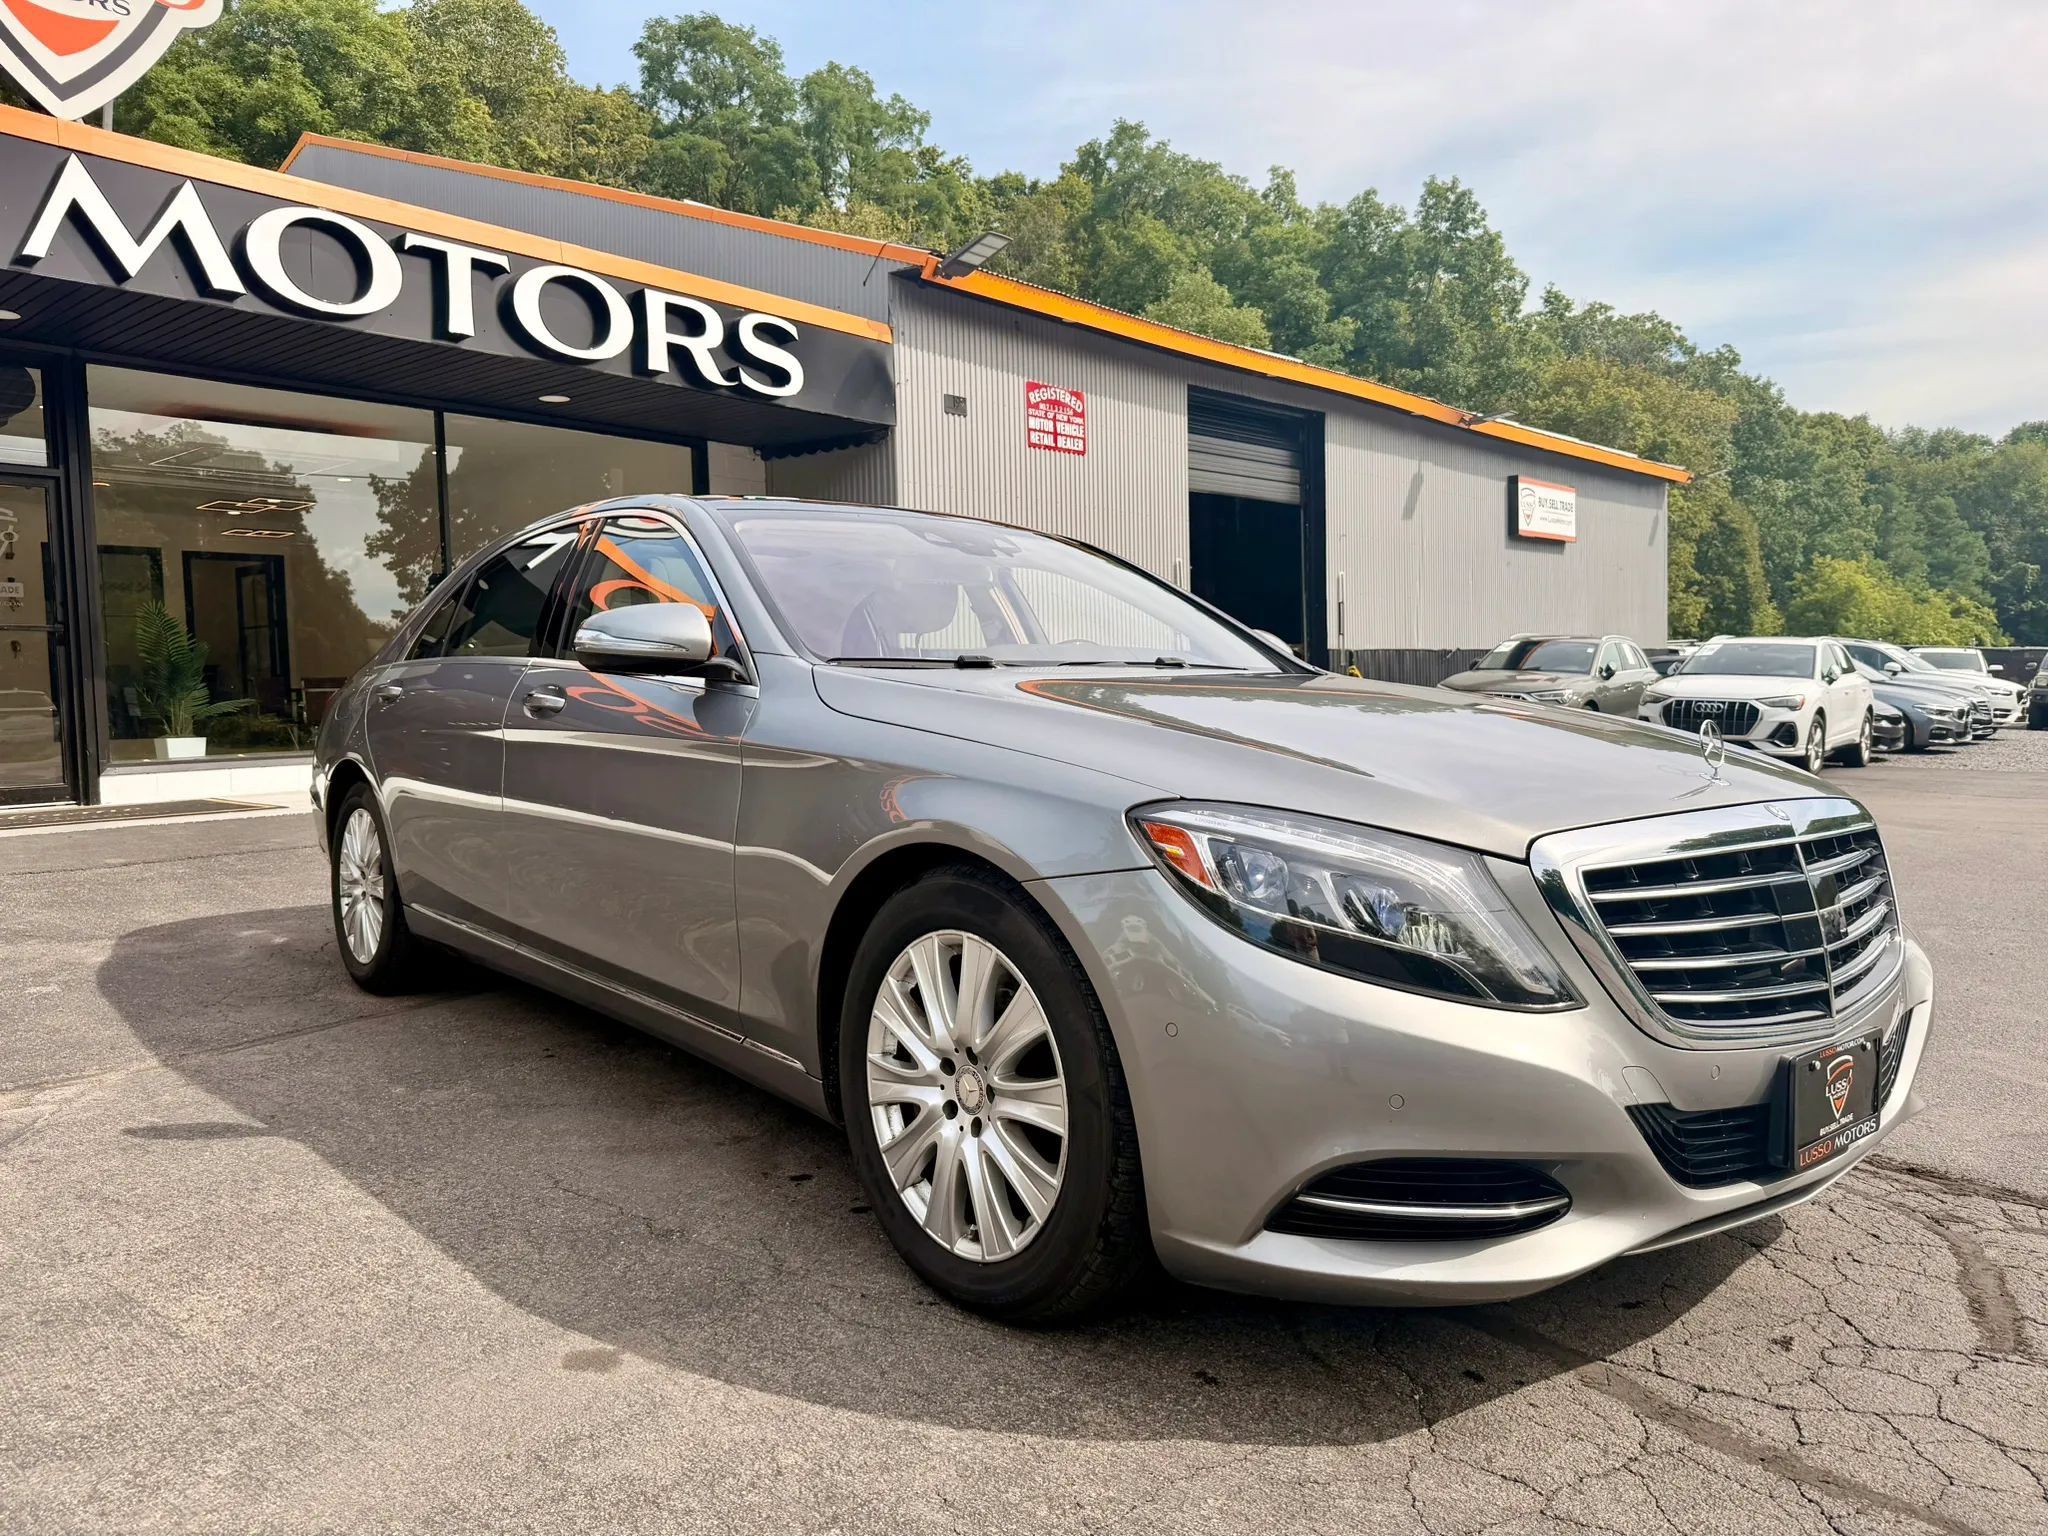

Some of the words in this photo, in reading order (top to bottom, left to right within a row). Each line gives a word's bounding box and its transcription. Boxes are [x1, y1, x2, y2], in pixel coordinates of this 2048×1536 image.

[22, 153, 804, 398] MOTORS
[1028, 387, 1084, 413] REGISTERED
[1028, 408, 1046, 418] STATE
[1047, 411, 1055, 419] OF
[1028, 416, 1054, 433] MOTOR
[1056, 421, 1085, 438] VEHICLE
[1030, 430, 1056, 447] RETAIL
[1057, 435, 1084, 451] DEALER
[1560, 500, 1573, 512] TRADE
[1800, 1140, 1832, 1167] LUSSO
[1833, 1117, 1877, 1150] MOTORS
